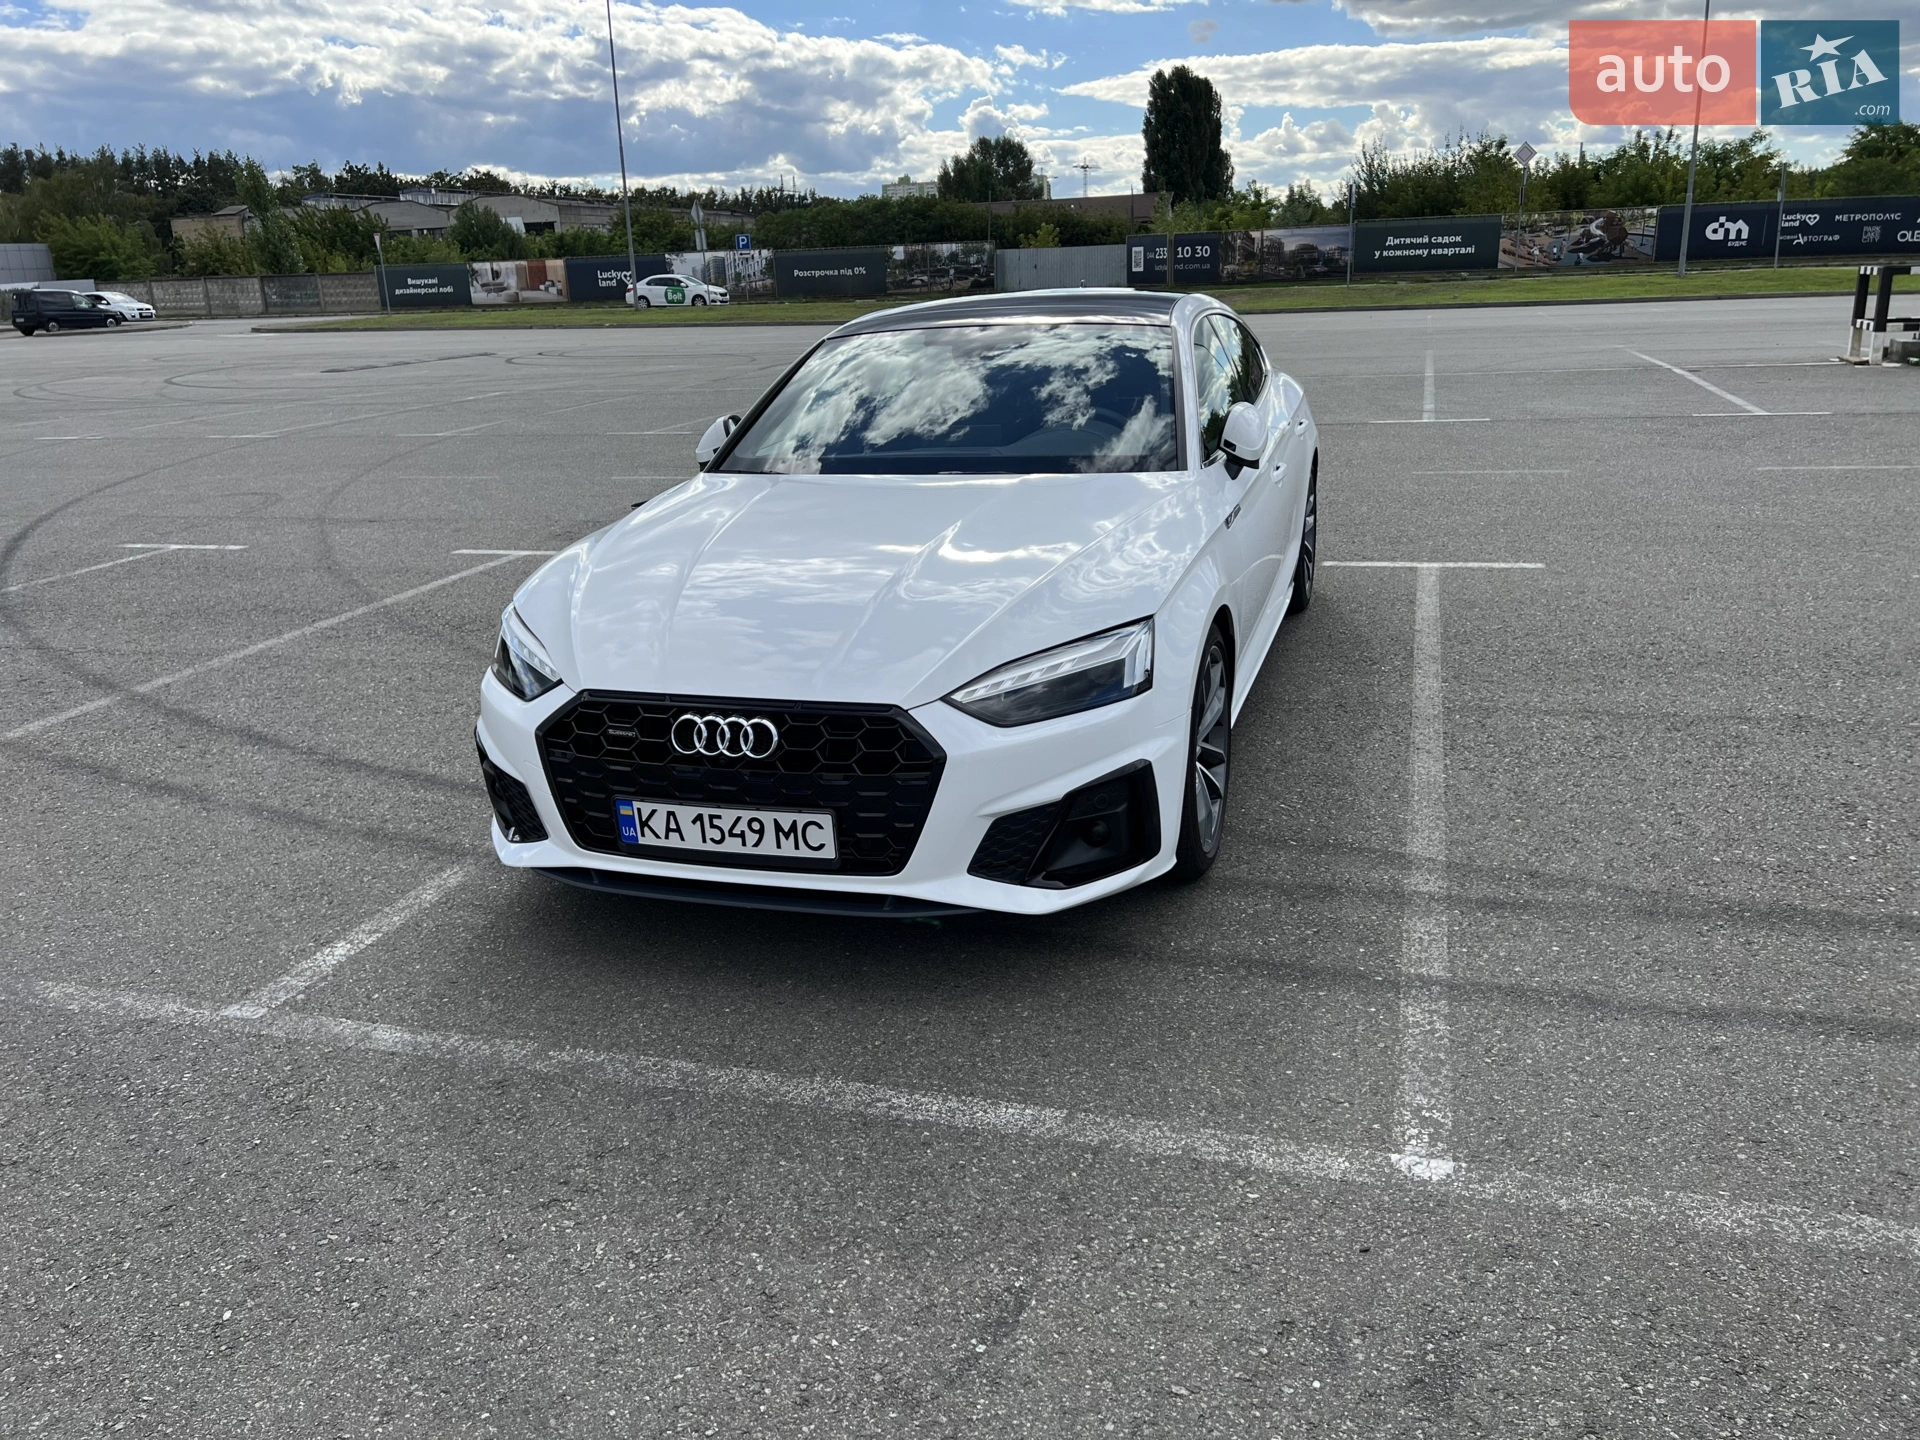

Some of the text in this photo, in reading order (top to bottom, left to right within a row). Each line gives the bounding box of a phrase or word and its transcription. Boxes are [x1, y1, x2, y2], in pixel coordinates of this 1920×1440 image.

[1782, 213, 1807, 222] Lucky
[738, 236, 748, 249] P
[1385, 234, 1462, 247] Дитячий садок
[1155, 247, 1168, 259] 233
[1176, 246, 1192, 258] 10
[1195, 245, 1211, 257] 30
[1374, 245, 1475, 259] у кожному кварталі
[597, 269, 622, 280] Lucky
[793, 267, 867, 278] Розстрочка під 0%
[407, 277, 438, 286] Вишукані
[598, 278, 617, 287] land
[395, 285, 454, 295] дизайнерські лобі
[667, 290, 683, 301] Bolt
[622, 826, 636, 837] UA
[636, 807, 826, 852] KA 1549 MC
